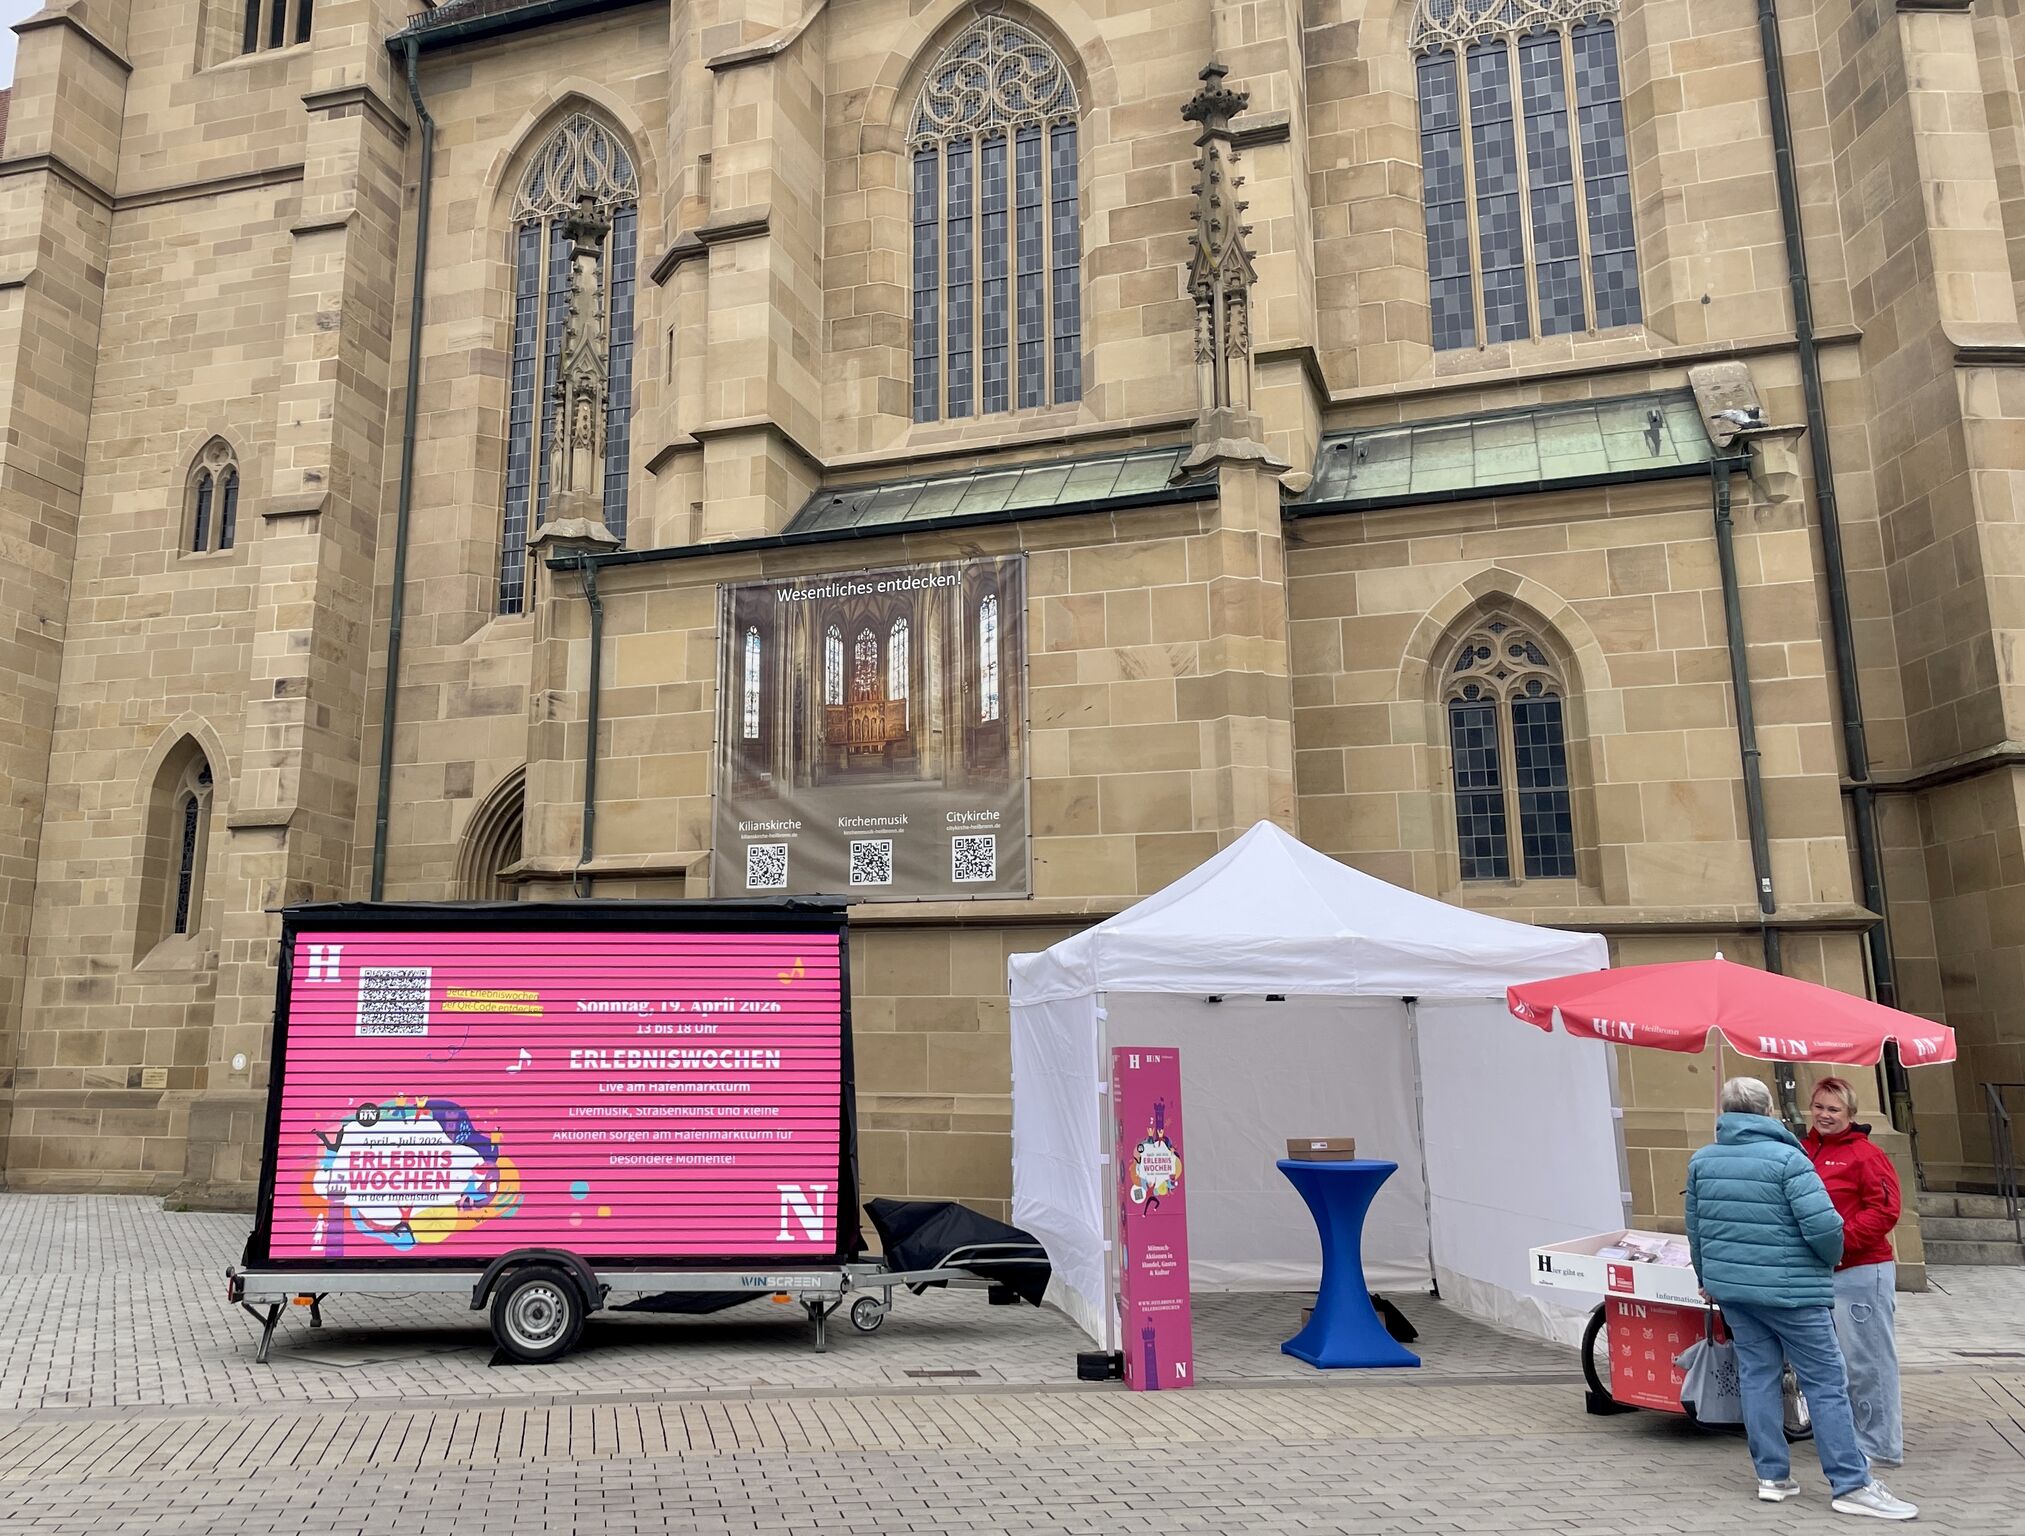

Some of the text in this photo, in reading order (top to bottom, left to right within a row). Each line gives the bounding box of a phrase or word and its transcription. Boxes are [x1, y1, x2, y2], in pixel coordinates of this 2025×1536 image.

[777, 571, 962, 602] Wesentliches entdecken!
[838, 814, 908, 827] Kirchenmusik
[946, 809, 1000, 823] Citykirche
[738, 819, 802, 832] Kilianskirche
[304, 945, 344, 983] H
[576, 998, 654, 1017] Sonntag,
[690, 997, 735, 1017] April
[569, 1049, 781, 1069] ERLEBNISWOCHEN
[1129, 1054, 1140, 1069] H
[598, 1081, 624, 1092] Live
[626, 1084, 645, 1092] am
[609, 1131, 650, 1142] sorgen
[652, 1131, 671, 1140] am
[349, 1150, 453, 1169] ERLEBNIS
[349, 1170, 451, 1190] WOCHEN
[776, 1184, 829, 1241] N
[741, 1276, 821, 1287] WINSCREEN
[1175, 1362, 1187, 1379] N
